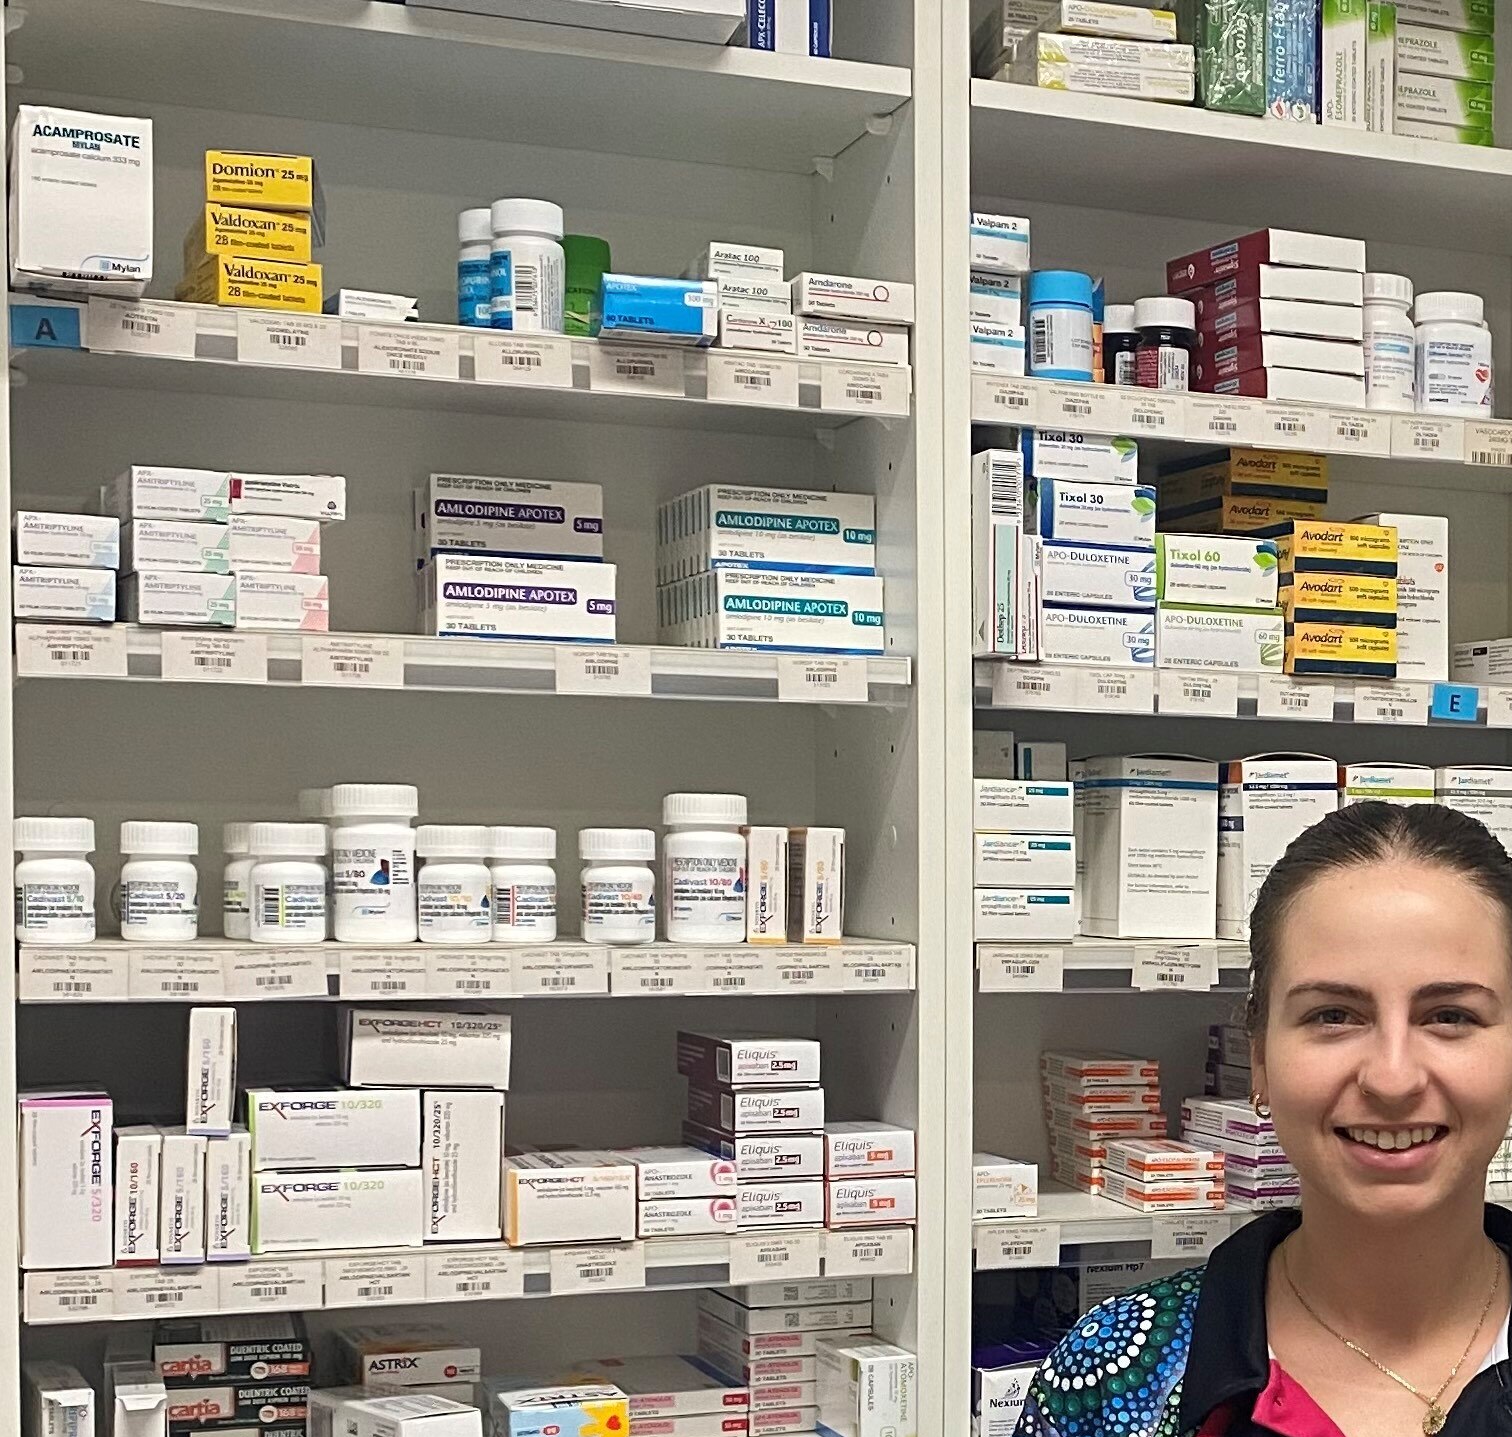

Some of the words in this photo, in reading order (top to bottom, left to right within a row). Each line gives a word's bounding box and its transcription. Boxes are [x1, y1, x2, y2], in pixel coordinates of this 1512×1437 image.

[32, 124, 141, 149] ACAMPROSATE
[72, 140, 102, 152] MYLAN
[211, 161, 276, 179] Domion
[280, 169, 296, 181] 25
[210, 211, 277, 231] Valdoxan
[281, 222, 295, 233] 25
[976, 217, 1010, 230] Valpam
[1010, 221, 1019, 231] 2
[713, 249, 742, 262] Aratac
[111, 261, 142, 274] Mylan
[223, 262, 289, 284] Valdoxan
[292, 274, 306, 286] 25
[721, 283, 747, 296] Aratac
[748, 286, 769, 297] 100
[34, 317, 57, 341] A
[972, 324, 1005, 337] Valpam
[1005, 328, 1015, 338] 2
[1235, 457, 1277, 472] Avodart
[1059, 491, 1088, 504] Tixol
[1088, 493, 1105, 505] 30
[436, 501, 517, 519] AMLODIPINE
[517, 507, 564, 523] APOTEX
[717, 513, 794, 530] AMLODIPINE
[795, 517, 839, 533] APOTEX
[1299, 529, 1344, 545] Avodart
[1046, 550, 1131, 565] APO-DULOXETINE
[1169, 548, 1203, 562] Tixol
[1204, 550, 1222, 563] 60
[1128, 573, 1140, 584] 30
[1139, 575, 1153, 586] mg
[444, 583, 528, 602] AMLODIPINE
[528, 588, 577, 604] APOTEX
[1299, 580, 1344, 595] Avodart
[725, 598, 803, 614] AMLODIPINE
[803, 600, 847, 615] APOTEX
[1044, 612, 1129, 627] APO-DULOXETINE
[1164, 614, 1245, 629] APO-DULOXETINE
[1126, 635, 1138, 645] 30
[1137, 636, 1151, 647] mg
[1300, 631, 1344, 647] Avodart
[1449, 693, 1461, 713] E
[736, 1048, 777, 1062] Eliquis
[258, 1100, 337, 1114] EXFORGE
[339, 1099, 384, 1110] 10/320
[738, 1096, 781, 1109] Eliquis
[89, 1108, 102, 1187] EXFORGE
[740, 1143, 782, 1156] Eliquis
[833, 1139, 874, 1152] Eliquis
[260, 1180, 341, 1195] EXFORGE
[342, 1179, 386, 1193] 10/320
[835, 1187, 877, 1200] Eliquis
[740, 1190, 783, 1203] Eliquis
[90, 1186, 102, 1223] 5/320
[1125, 1262, 1145, 1274] Hp7
[159, 1354, 214, 1375] cartia
[368, 1356, 419, 1373] ASTRIX
[167, 1399, 221, 1419] cartia
